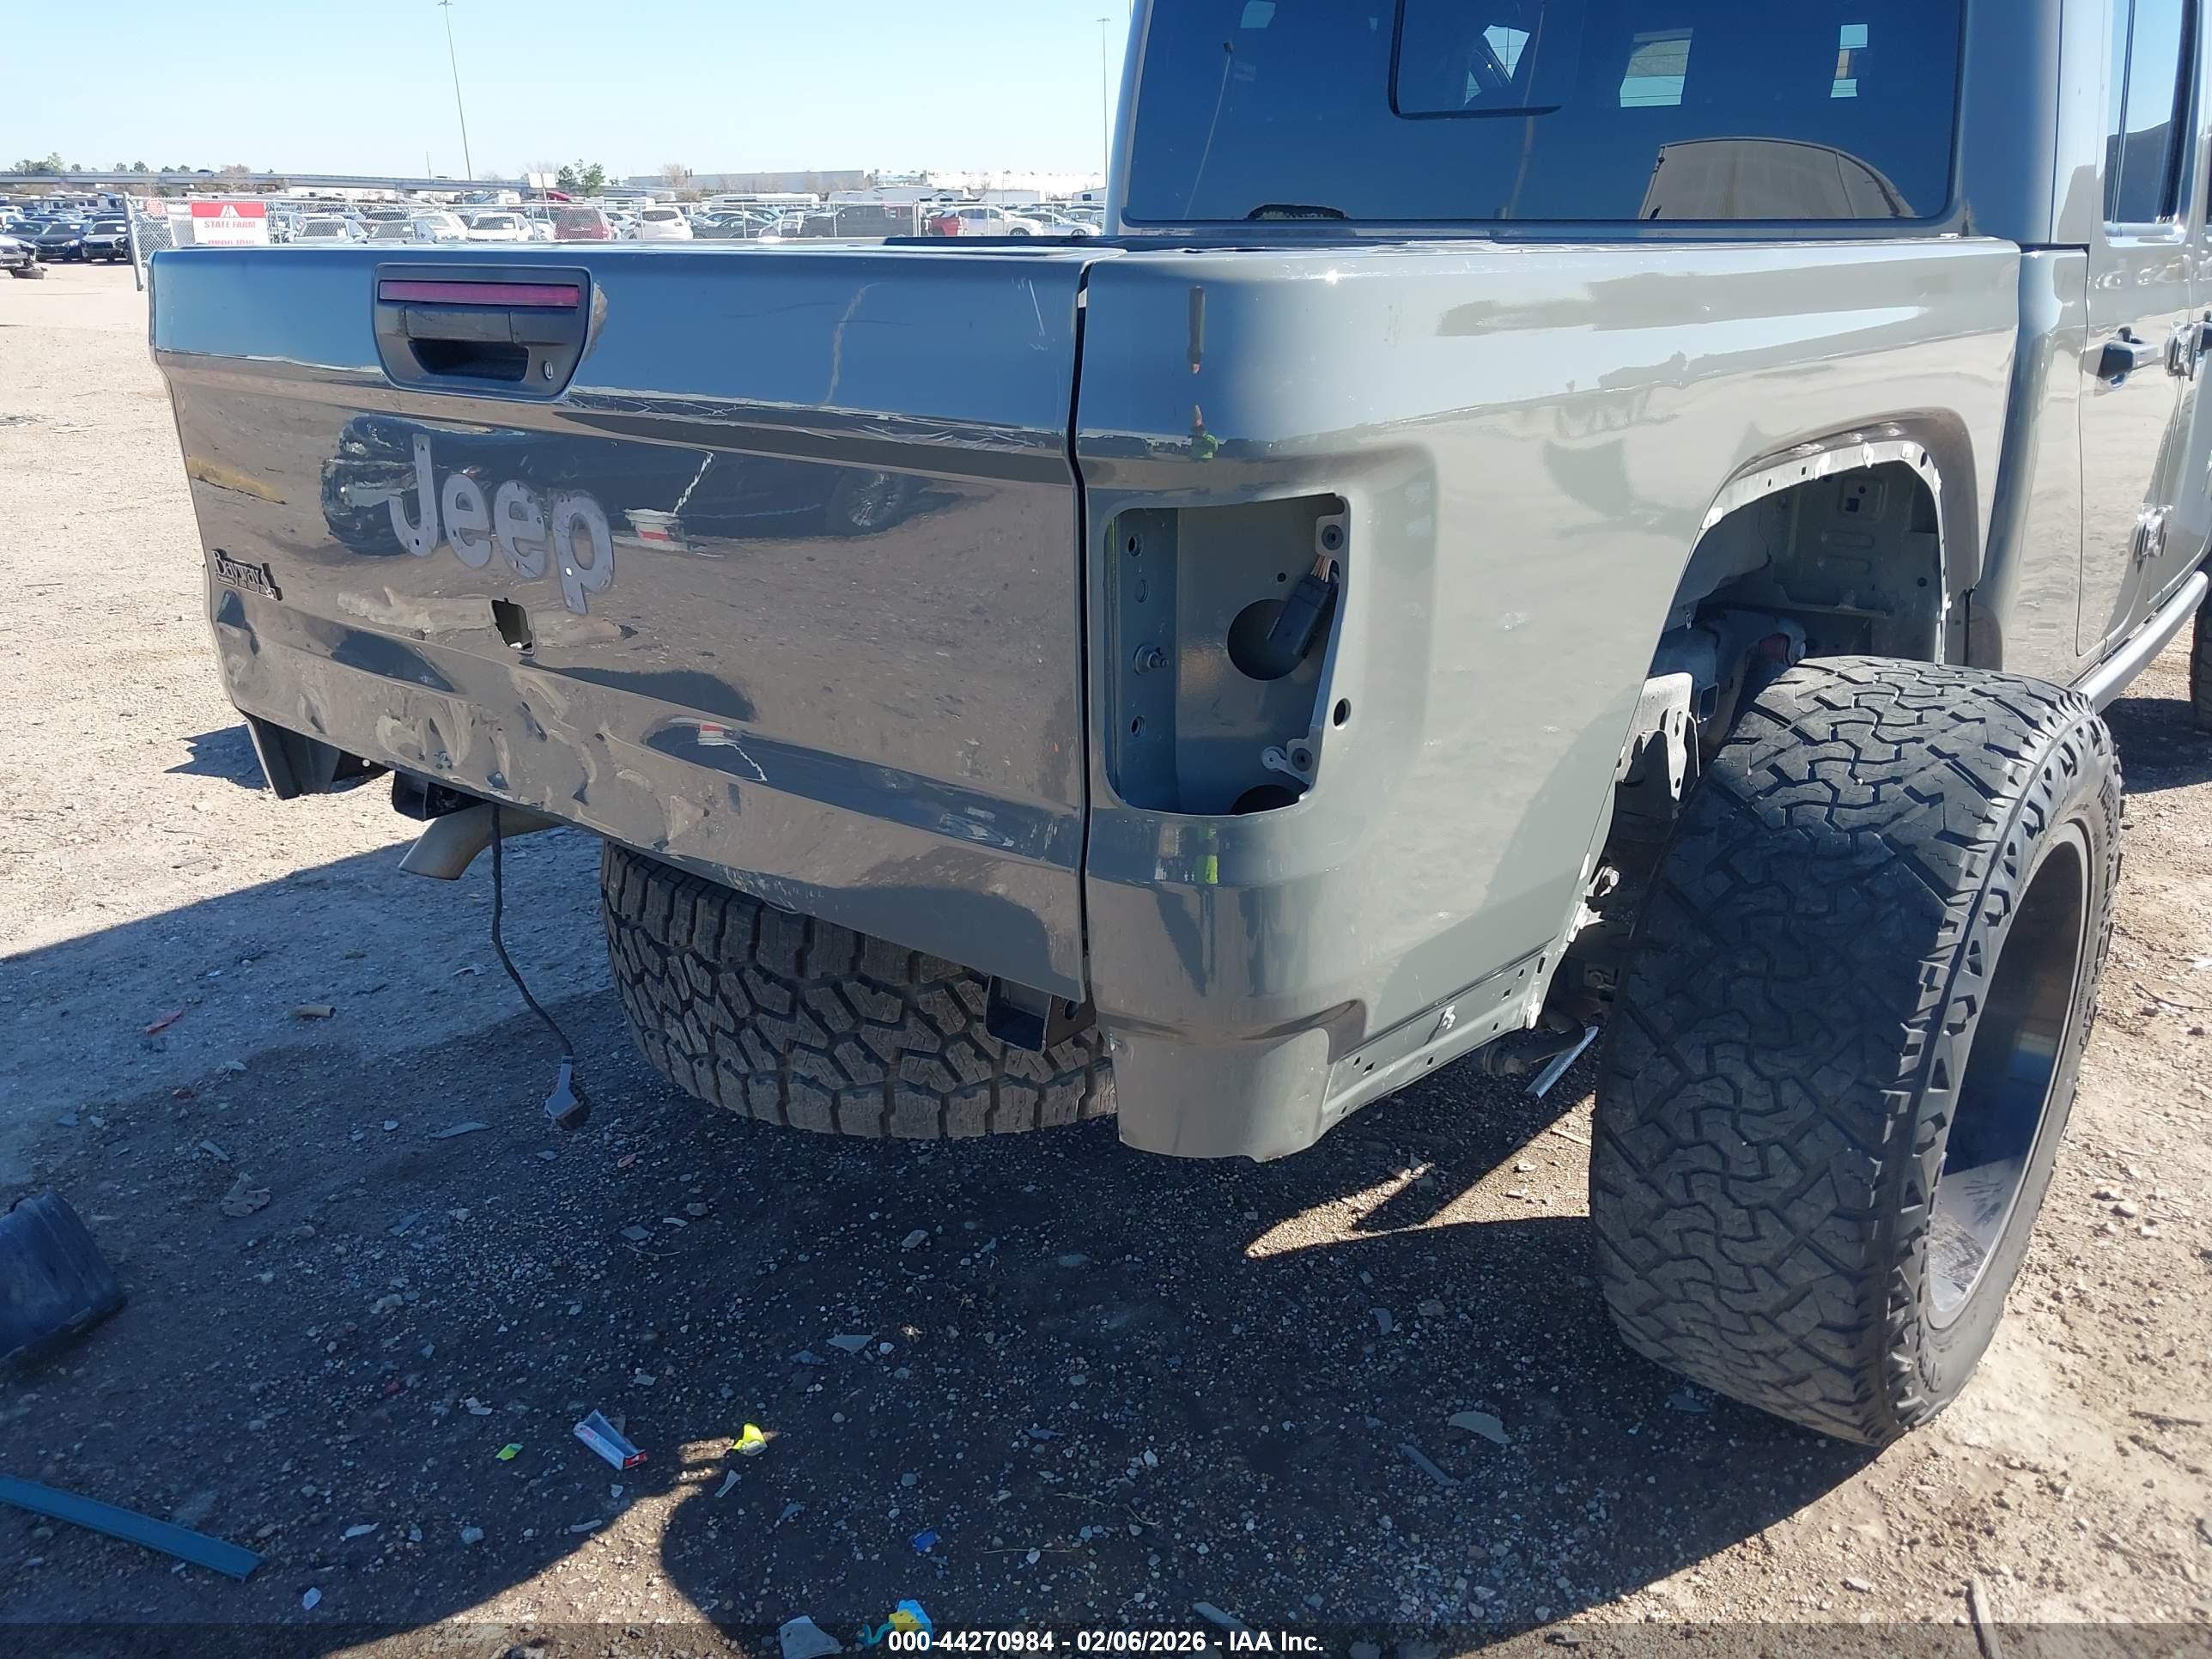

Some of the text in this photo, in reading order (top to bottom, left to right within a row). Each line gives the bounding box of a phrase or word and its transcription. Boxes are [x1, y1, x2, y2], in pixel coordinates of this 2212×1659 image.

[204, 220, 256, 228] STATE FARM
[387, 433, 615, 615] Jeep
